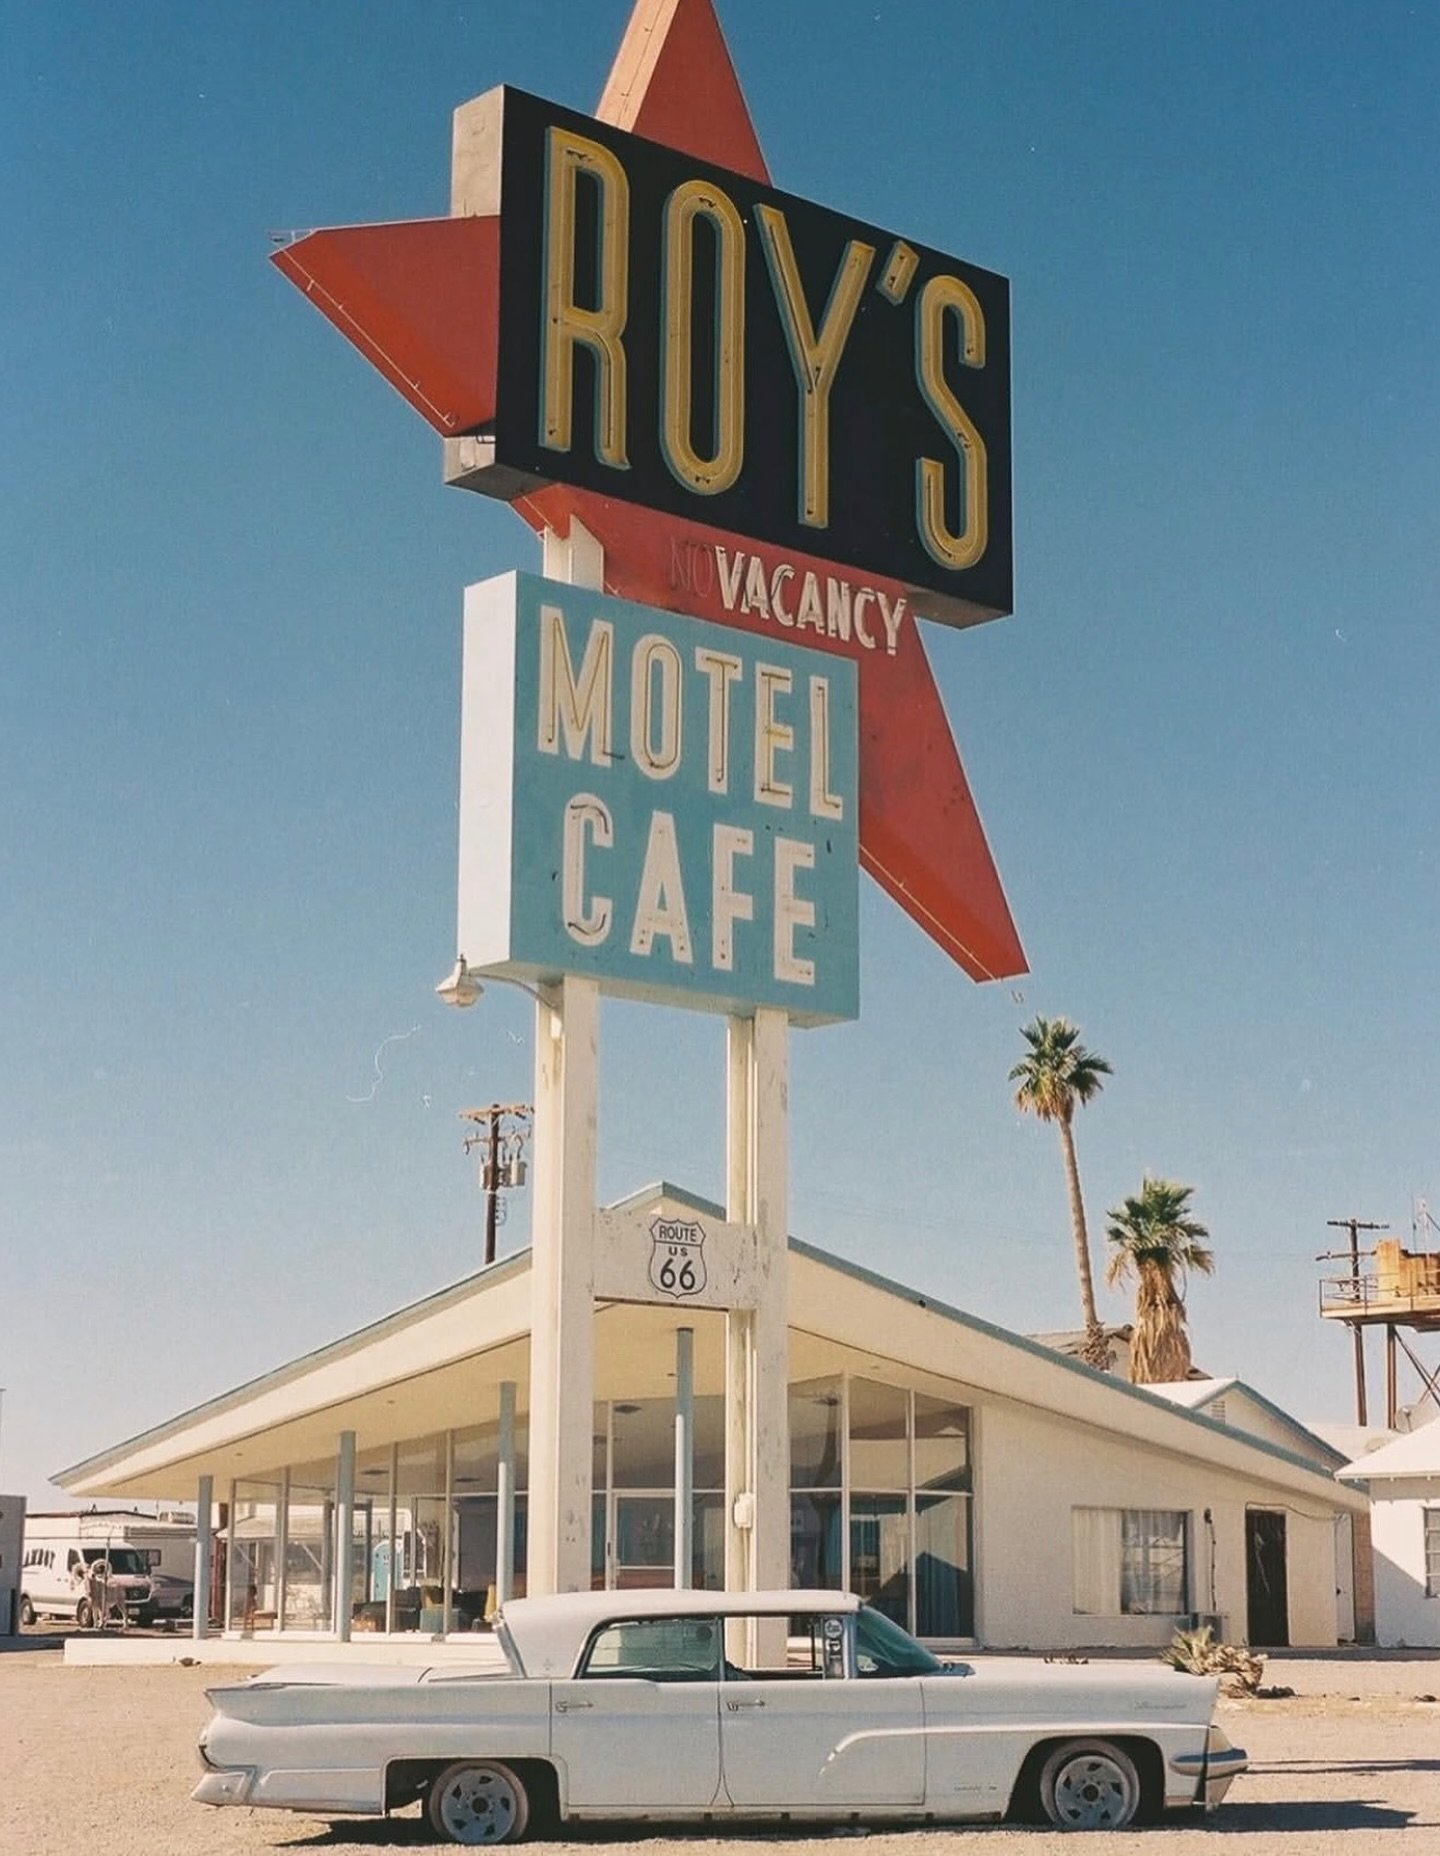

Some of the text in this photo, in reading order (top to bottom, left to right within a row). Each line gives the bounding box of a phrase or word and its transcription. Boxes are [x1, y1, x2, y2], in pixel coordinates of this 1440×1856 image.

[538, 125, 988, 571] ROY'S
[715, 545, 907, 656] VACANCY
[537, 605, 844, 821] MOTEL
[562, 792, 816, 986] CAFE
[659, 1225, 697, 1242] ROUTE
[660, 1258, 696, 1290] 66
[668, 1246, 688, 1256] US
